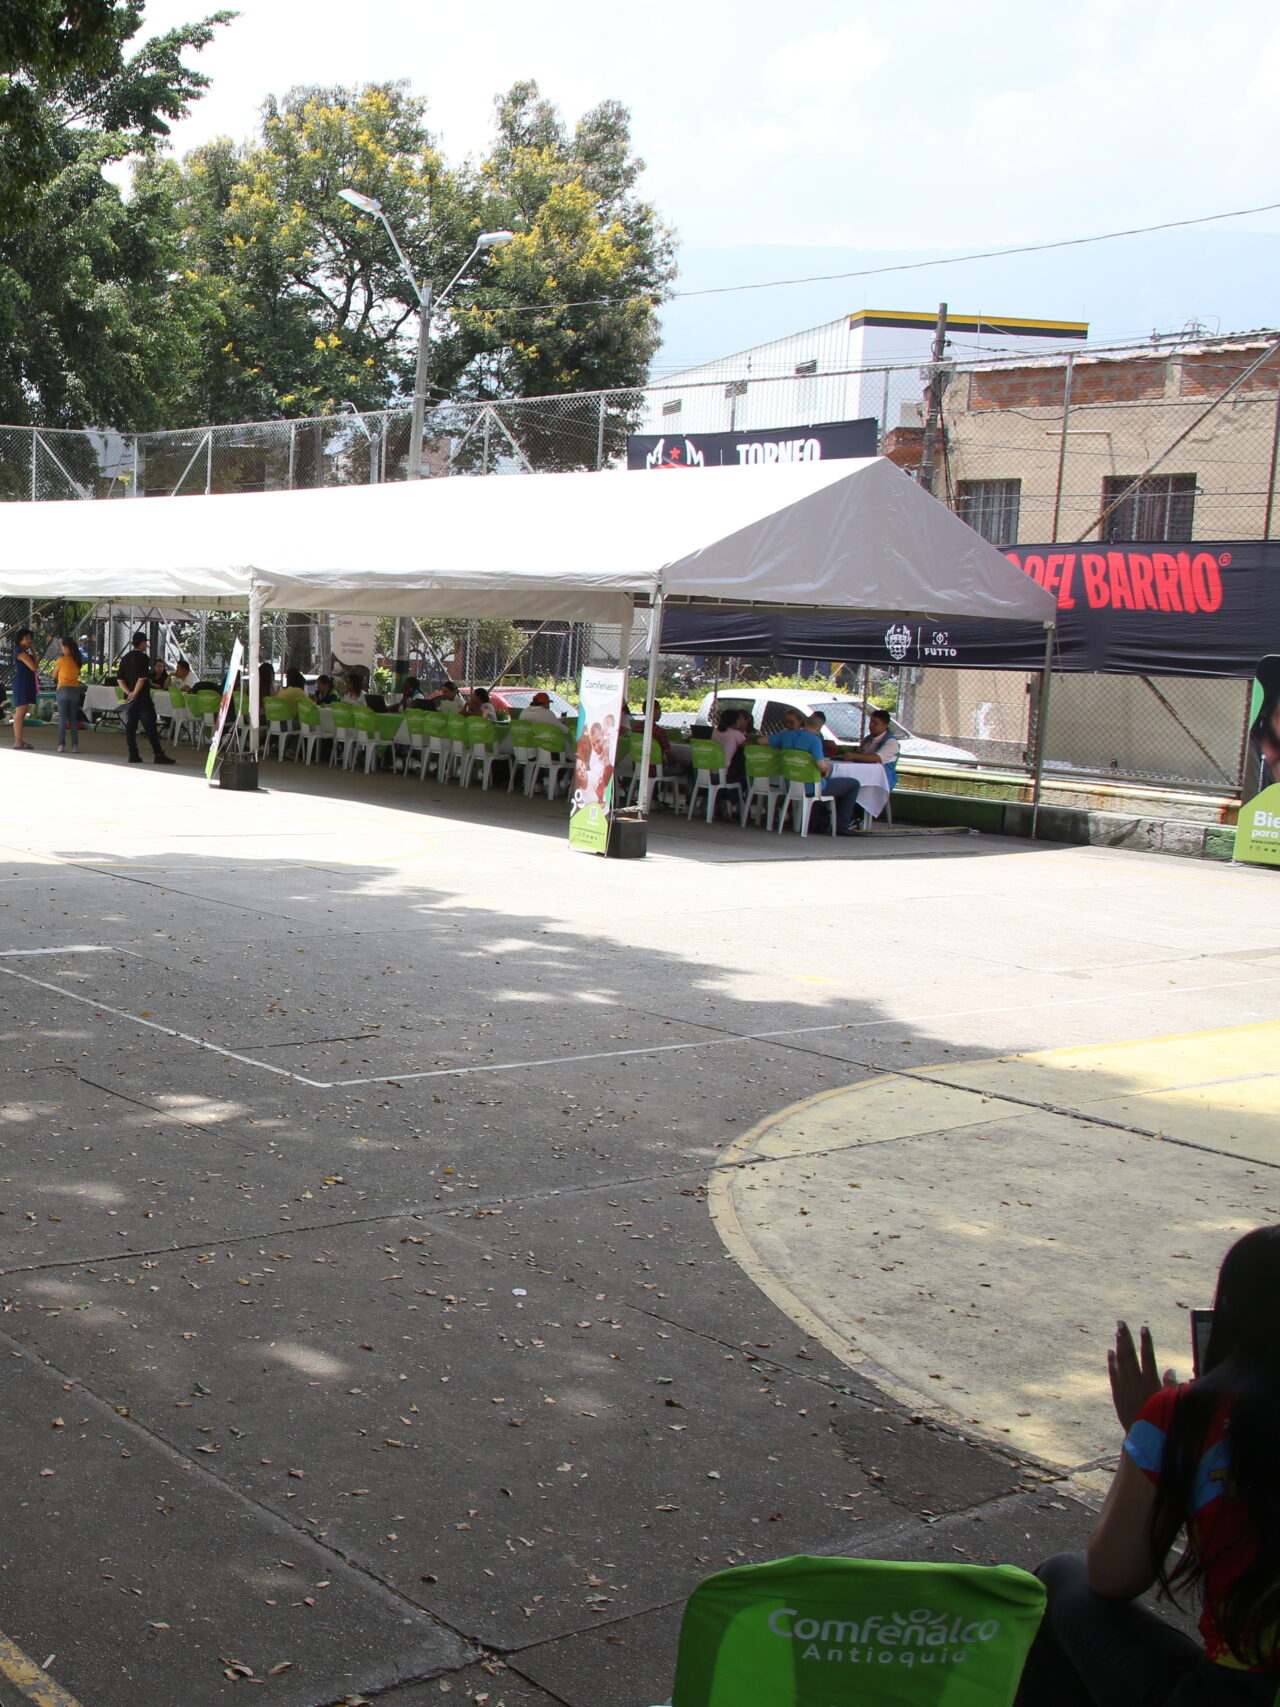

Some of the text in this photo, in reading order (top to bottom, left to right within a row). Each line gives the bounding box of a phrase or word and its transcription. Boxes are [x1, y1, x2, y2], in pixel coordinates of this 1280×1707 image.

[924, 647, 957, 657] FUTTO
[1251, 829, 1279, 839] para
[767, 1607, 1000, 1647] Comfenalco
[802, 1642, 969, 1669] Antioquia
